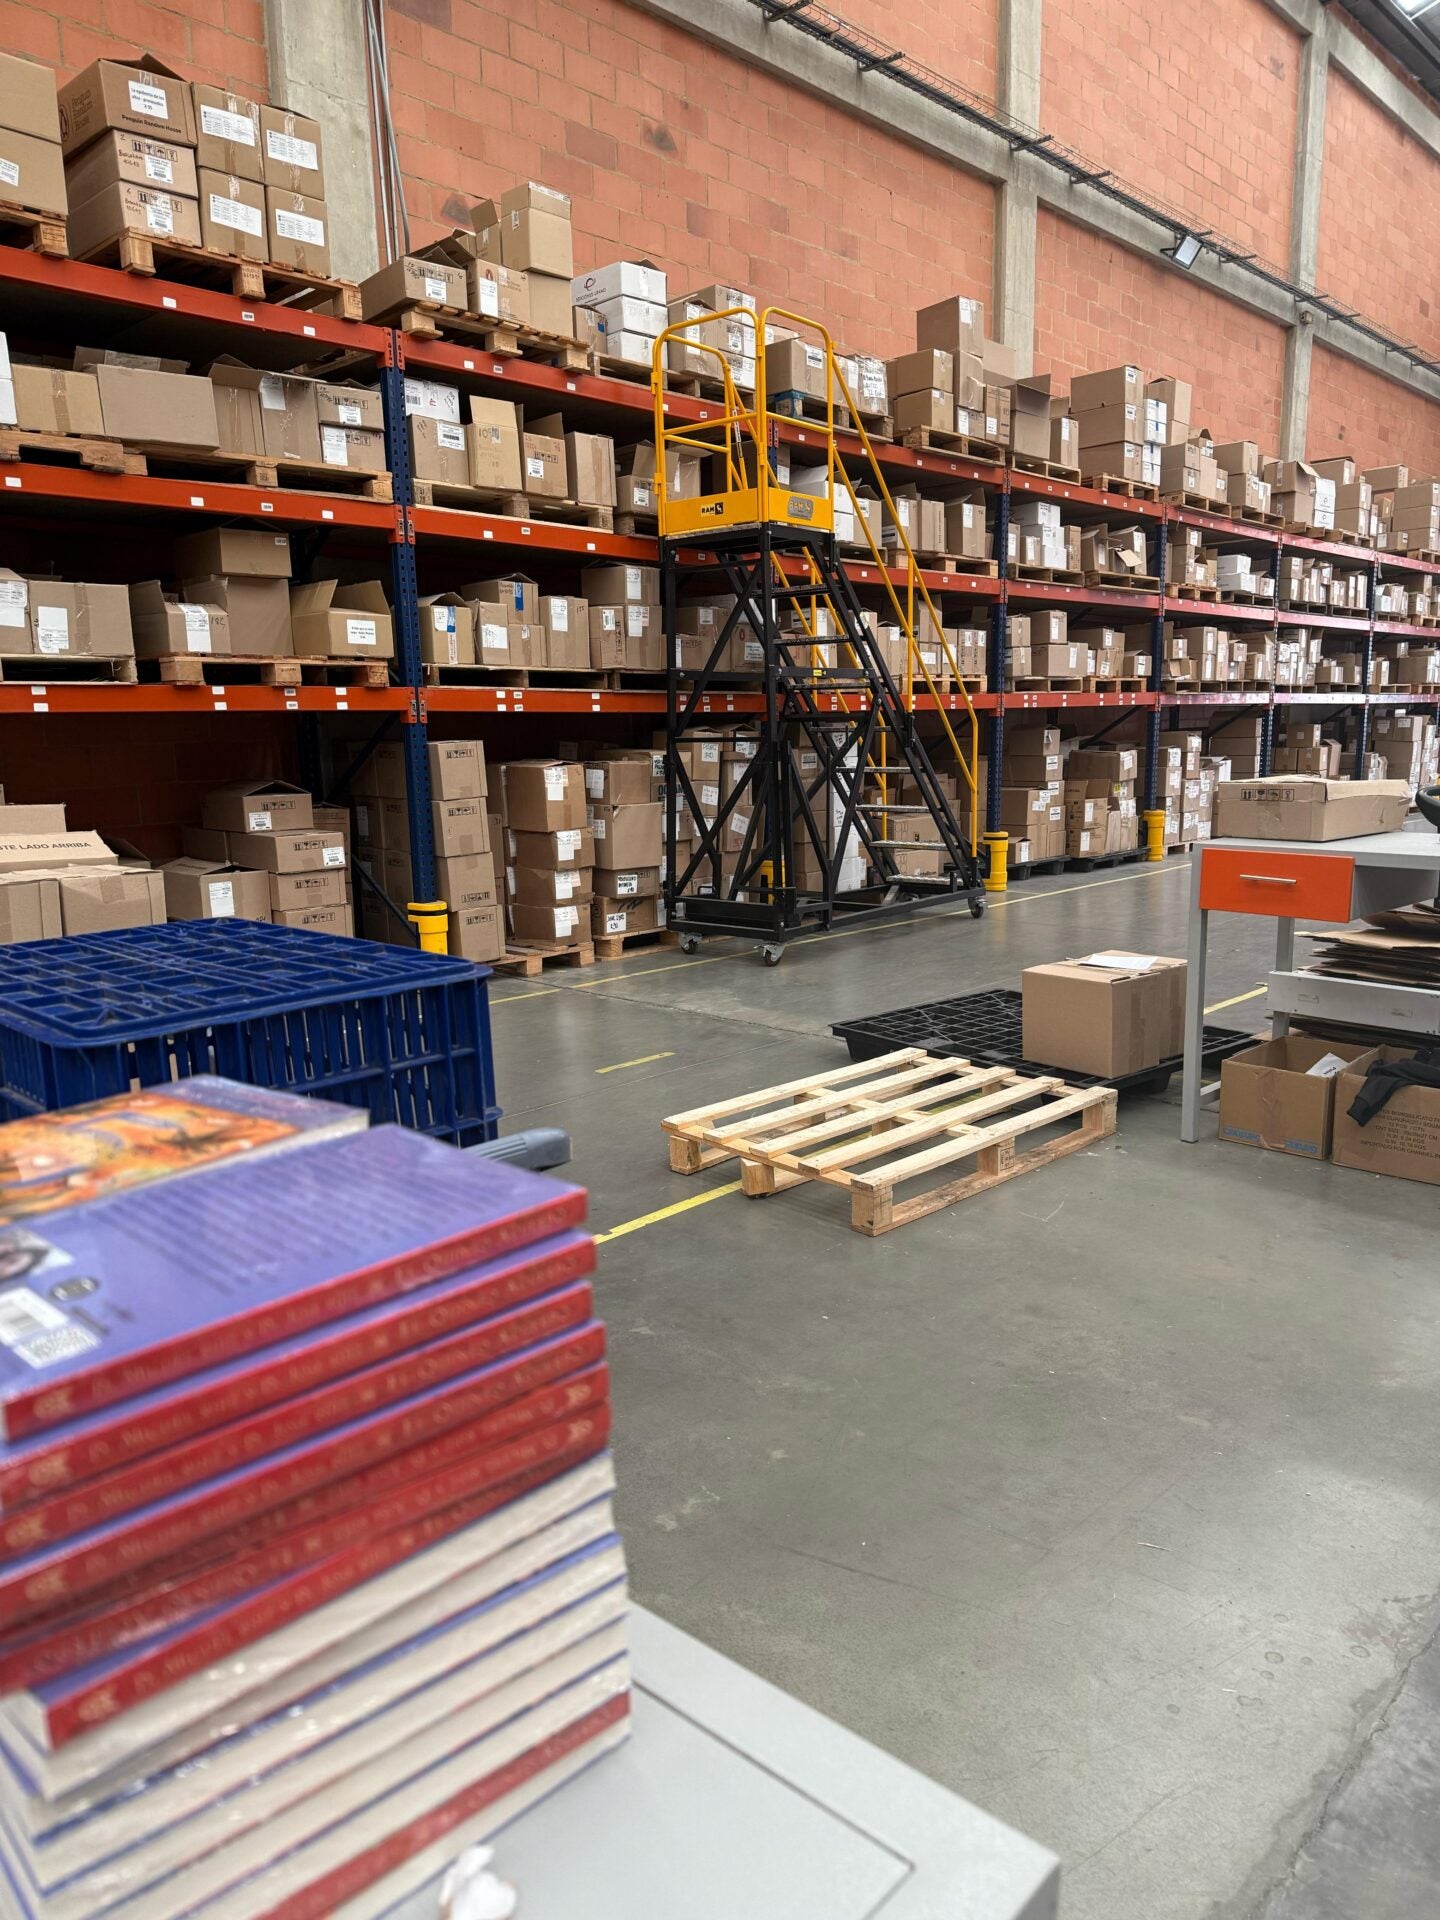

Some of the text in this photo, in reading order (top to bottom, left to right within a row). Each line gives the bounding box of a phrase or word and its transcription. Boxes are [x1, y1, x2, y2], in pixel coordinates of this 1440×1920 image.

[121, 113, 182, 134] Penguin Random House
[1360, 1139, 1393, 1150] IMPORTADO
[1393, 1145, 1406, 1153] POR
